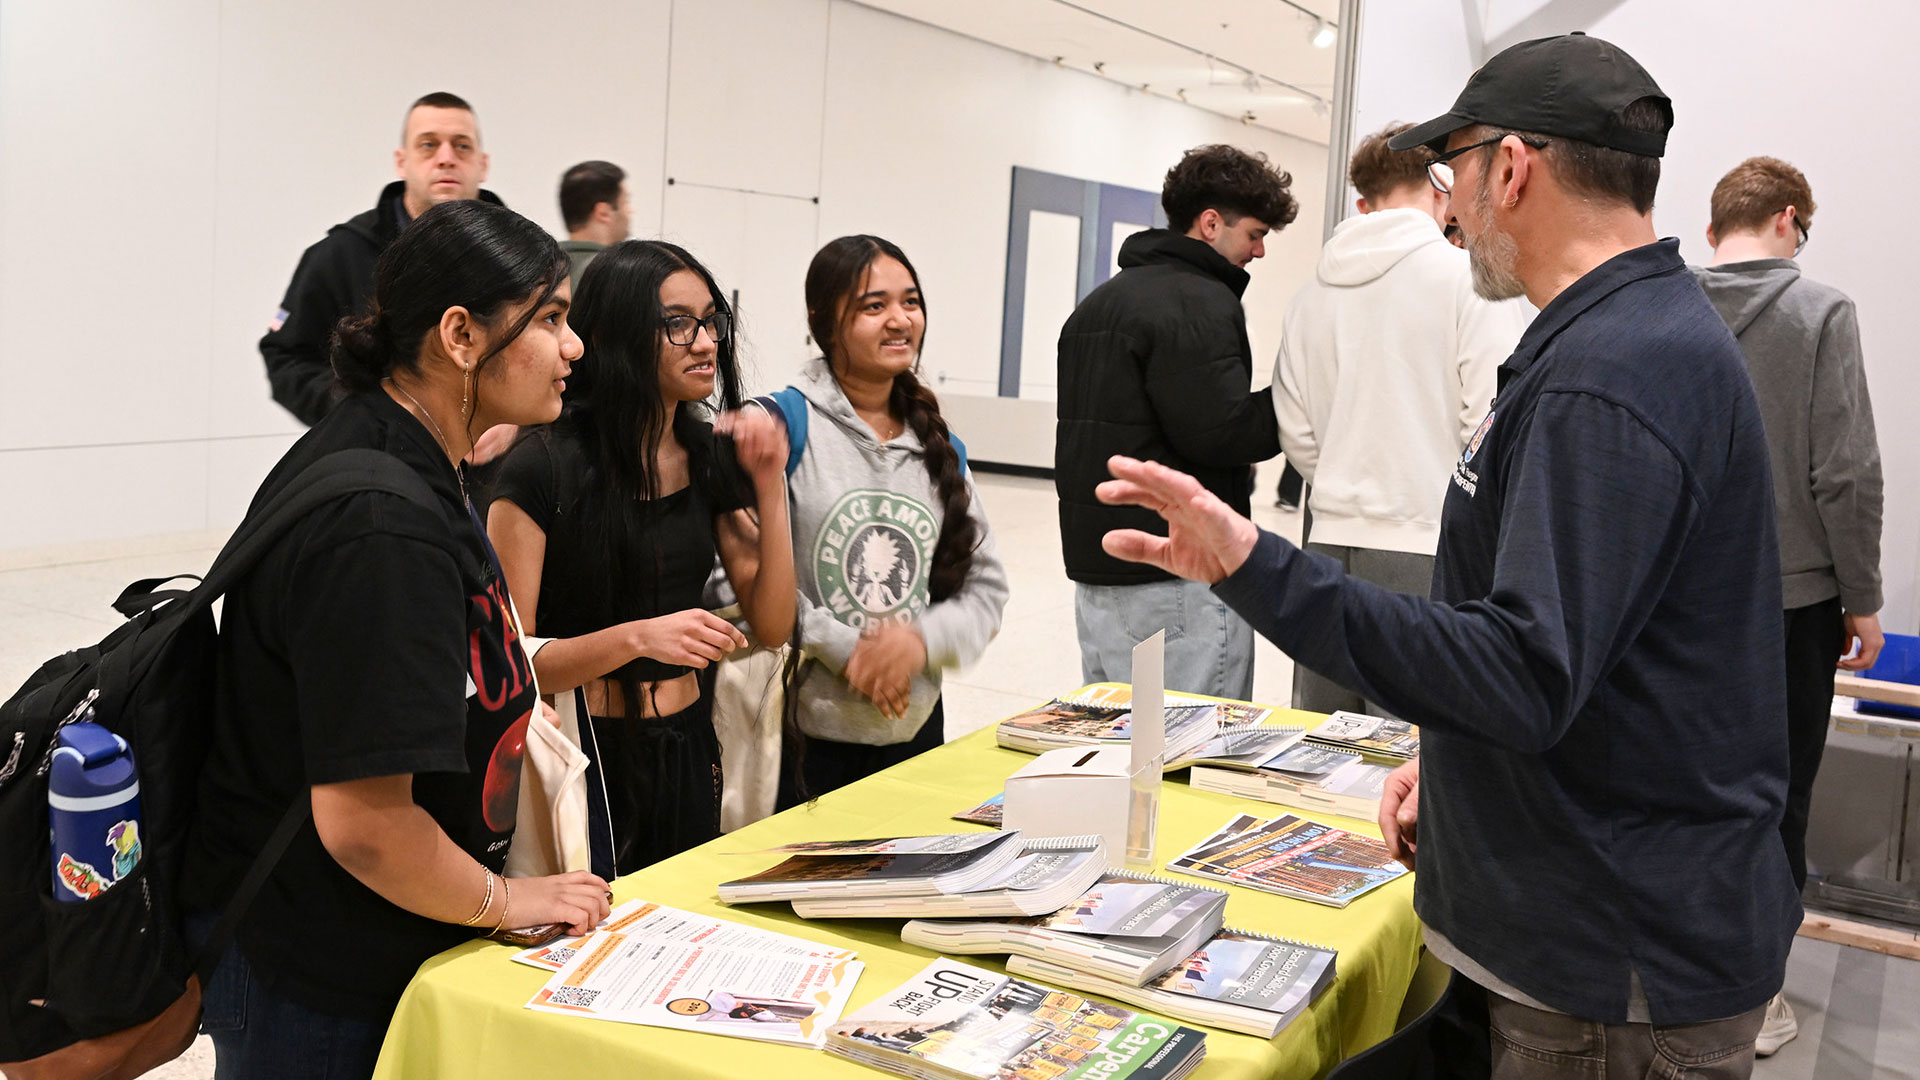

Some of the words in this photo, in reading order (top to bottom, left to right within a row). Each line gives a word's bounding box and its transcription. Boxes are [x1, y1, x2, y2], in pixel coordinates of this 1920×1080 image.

[820, 498, 872, 566] PEACE
[1120, 903, 1161, 931] Hardware
[1276, 948, 1307, 977] Standard
[924, 969, 980, 999] UP
[956, 979, 996, 1005] STAND
[1264, 974, 1287, 990] Skills
[889, 991, 924, 1010] BACK
[906, 996, 942, 1017] FIGHT
[1074, 1022, 1169, 1080] Carpen
[1171, 1032, 1186, 1043] THE
[1143, 1040, 1177, 1070] PROFESSIONAL
